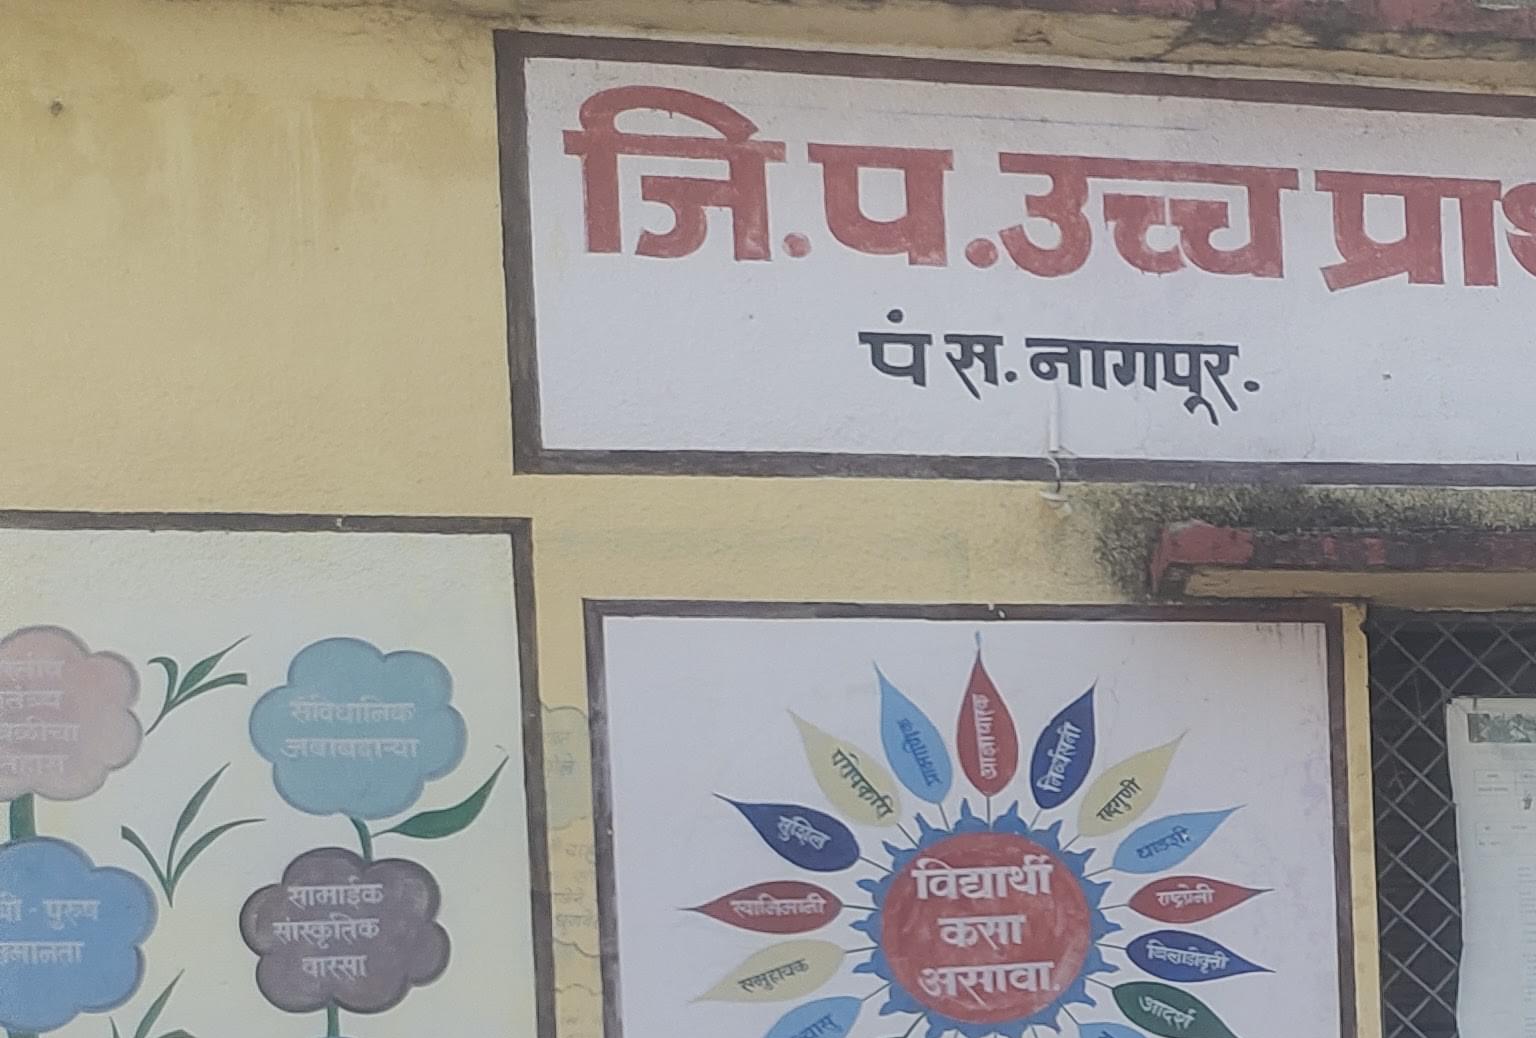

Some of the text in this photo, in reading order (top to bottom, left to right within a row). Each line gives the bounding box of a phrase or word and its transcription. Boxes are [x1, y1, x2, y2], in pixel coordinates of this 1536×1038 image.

[911, 855, 1053, 899] विद्यार्थी
[272, 912, 379, 949] सांस्कृतिक
[938, 915, 1027, 950] कसा
[1139, 996, 1196, 1029] आदर्श
